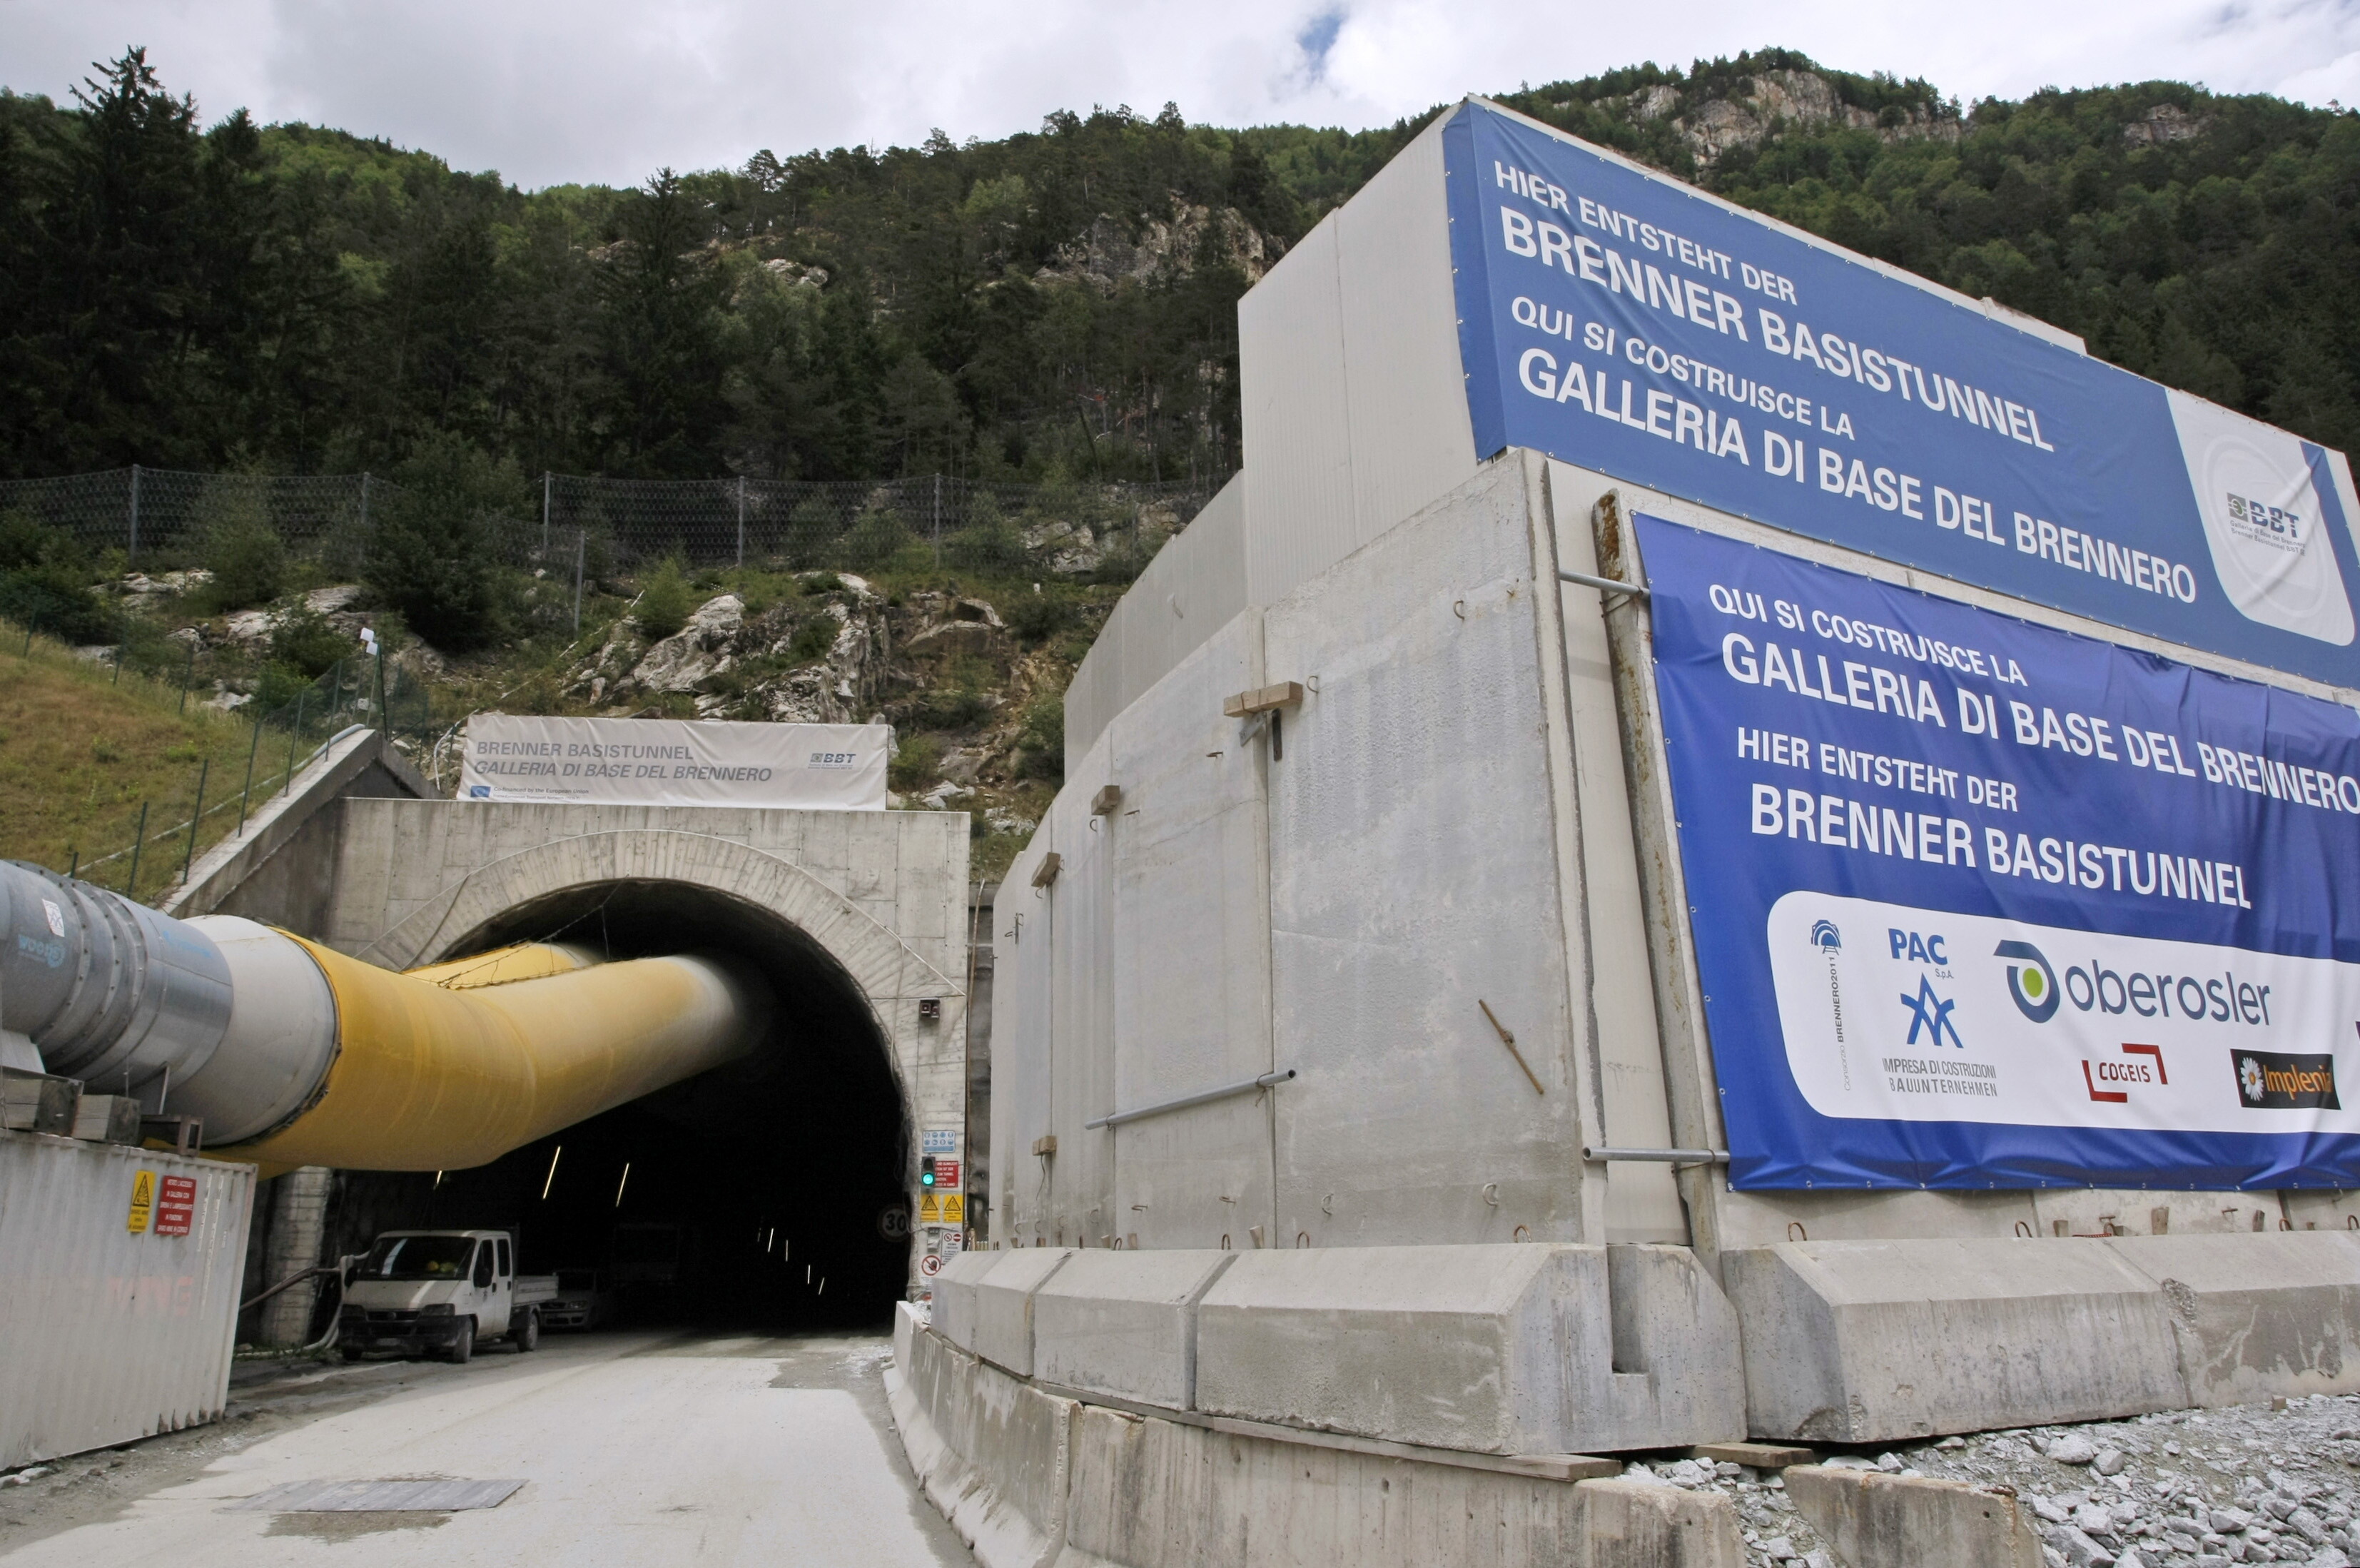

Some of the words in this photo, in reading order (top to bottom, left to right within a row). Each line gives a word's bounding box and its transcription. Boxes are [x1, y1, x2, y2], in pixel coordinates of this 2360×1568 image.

[1494, 161, 1569, 214] HIER
[1579, 196, 1731, 279] ENTSTEHT
[1742, 263, 1797, 305] DER
[1501, 206, 1748, 341] BRENNER
[1759, 308, 2054, 452] BASISTUNNEL
[1511, 296, 1572, 340] QUI
[1584, 322, 1614, 355] SI
[1626, 338, 1811, 426] COSTRUISCE
[1822, 406, 1855, 440] LA
[1519, 348, 1748, 465] GALLERIA
[1764, 430, 1804, 482] DI
[1819, 447, 1921, 520] BASE
[1934, 485, 2005, 547] DEL
[2014, 512, 2196, 604] BRENNERO
[2249, 500, 2299, 538] BBT
[1710, 585, 1766, 619] QUI
[1776, 600, 1804, 631] SI
[1812, 613, 1988, 679] COSTRUISCE
[1994, 654, 2027, 687] LA
[1723, 632, 1945, 727] GALLERIA
[1960, 687, 1998, 739] DI
[2016, 701, 2117, 762] BASE
[2124, 726, 2196, 778] DEL
[2200, 742, 2360, 814] BRENNERO
[474, 761, 557, 777] GALLERIA
[563, 763, 583, 777] DI
[584, 763, 632, 778] BASE
[636, 764, 668, 779] DEL
[672, 766, 771, 782] BRENNERO
[477, 742, 562, 757] BRENNER
[568, 744, 694, 760] BASISTUNNEL
[824, 754, 856, 763] BBT
[1738, 727, 1810, 772] HIER
[1821, 744, 1959, 799] ENTSTEHT
[1967, 774, 2017, 812] DER
[1751, 783, 1976, 869] BRENNER
[1987, 827, 2252, 909] BASISTUNNEL
[1888, 928, 1948, 965] PAC
[1935, 968, 1954, 979] S.p.A.
[2065, 959, 2271, 1026] oberosler
[1829, 956, 1844, 1043] BRENNERO2011
[1838, 1045, 1851, 1091] Consorzio
[1883, 1058, 1927, 1074] IMPRESA
[1929, 1060, 1940, 1074] DI
[1942, 1062, 1997, 1078] COSTRUZIONI
[1889, 1077, 1997, 1097] BAUUNTERNEHMEN
[2099, 1062, 2151, 1083] COGEIS
[886, 1213, 906, 1231] 30
